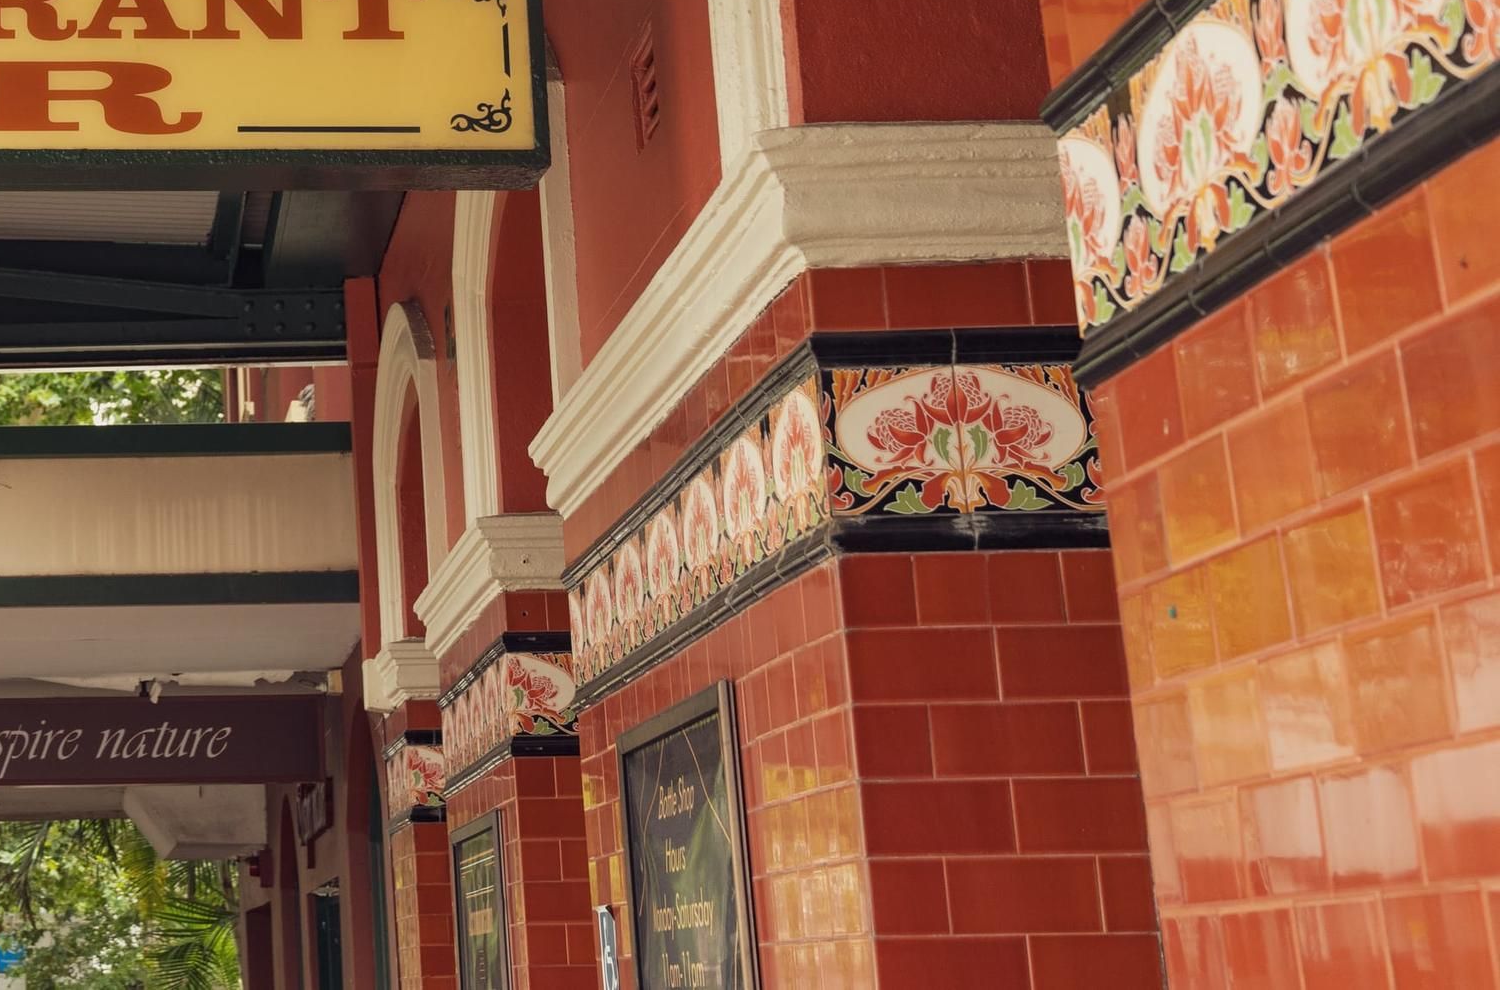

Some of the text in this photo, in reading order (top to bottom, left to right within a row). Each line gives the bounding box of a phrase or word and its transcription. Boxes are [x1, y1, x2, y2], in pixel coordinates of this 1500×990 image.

[95, 720, 232, 761] nature
[657, 774, 695, 820] Bottle Shop
[664, 837, 687, 873] Hours
